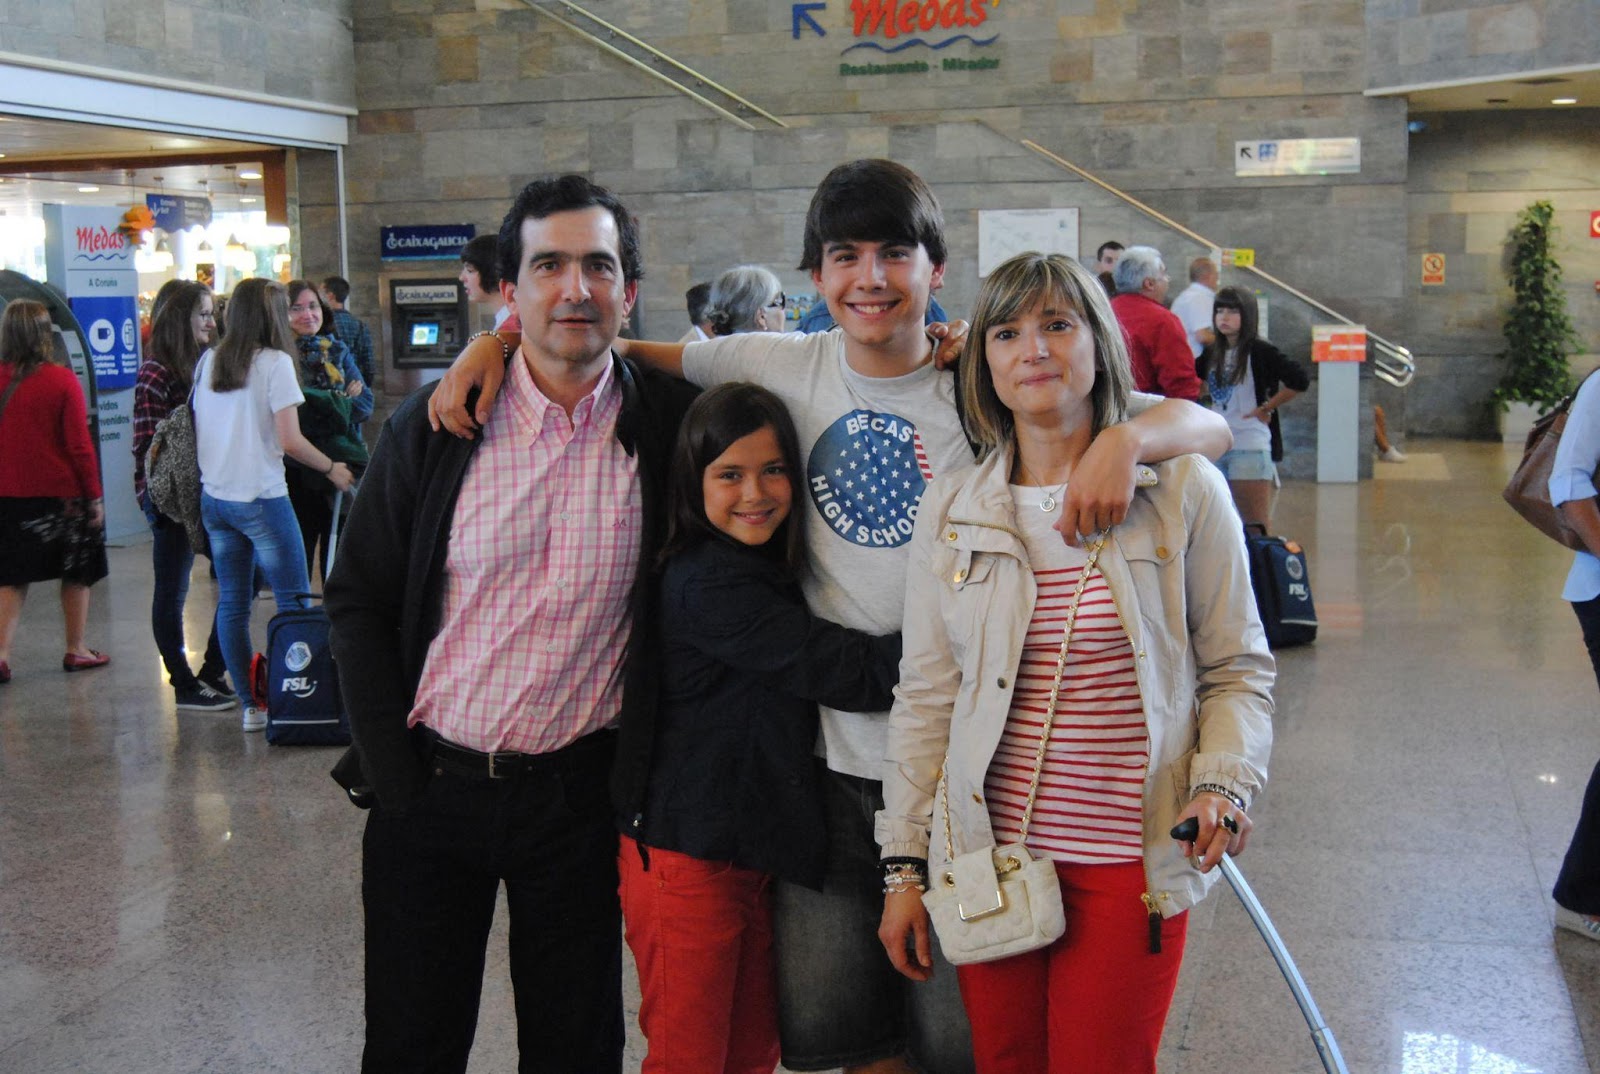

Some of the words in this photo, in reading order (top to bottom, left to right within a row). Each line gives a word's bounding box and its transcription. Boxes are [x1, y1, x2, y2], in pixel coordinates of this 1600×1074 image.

[76, 225, 124, 253] Medas
[100, 400, 119, 410] vidos
[101, 432, 121, 442] come
[845, 414, 913, 443] BECAS
[811, 475, 855, 534] HIGH
[855, 495, 923, 545] SCHOO
[1288, 584, 1306, 595] FSL
[281, 677, 311, 691] FSL
